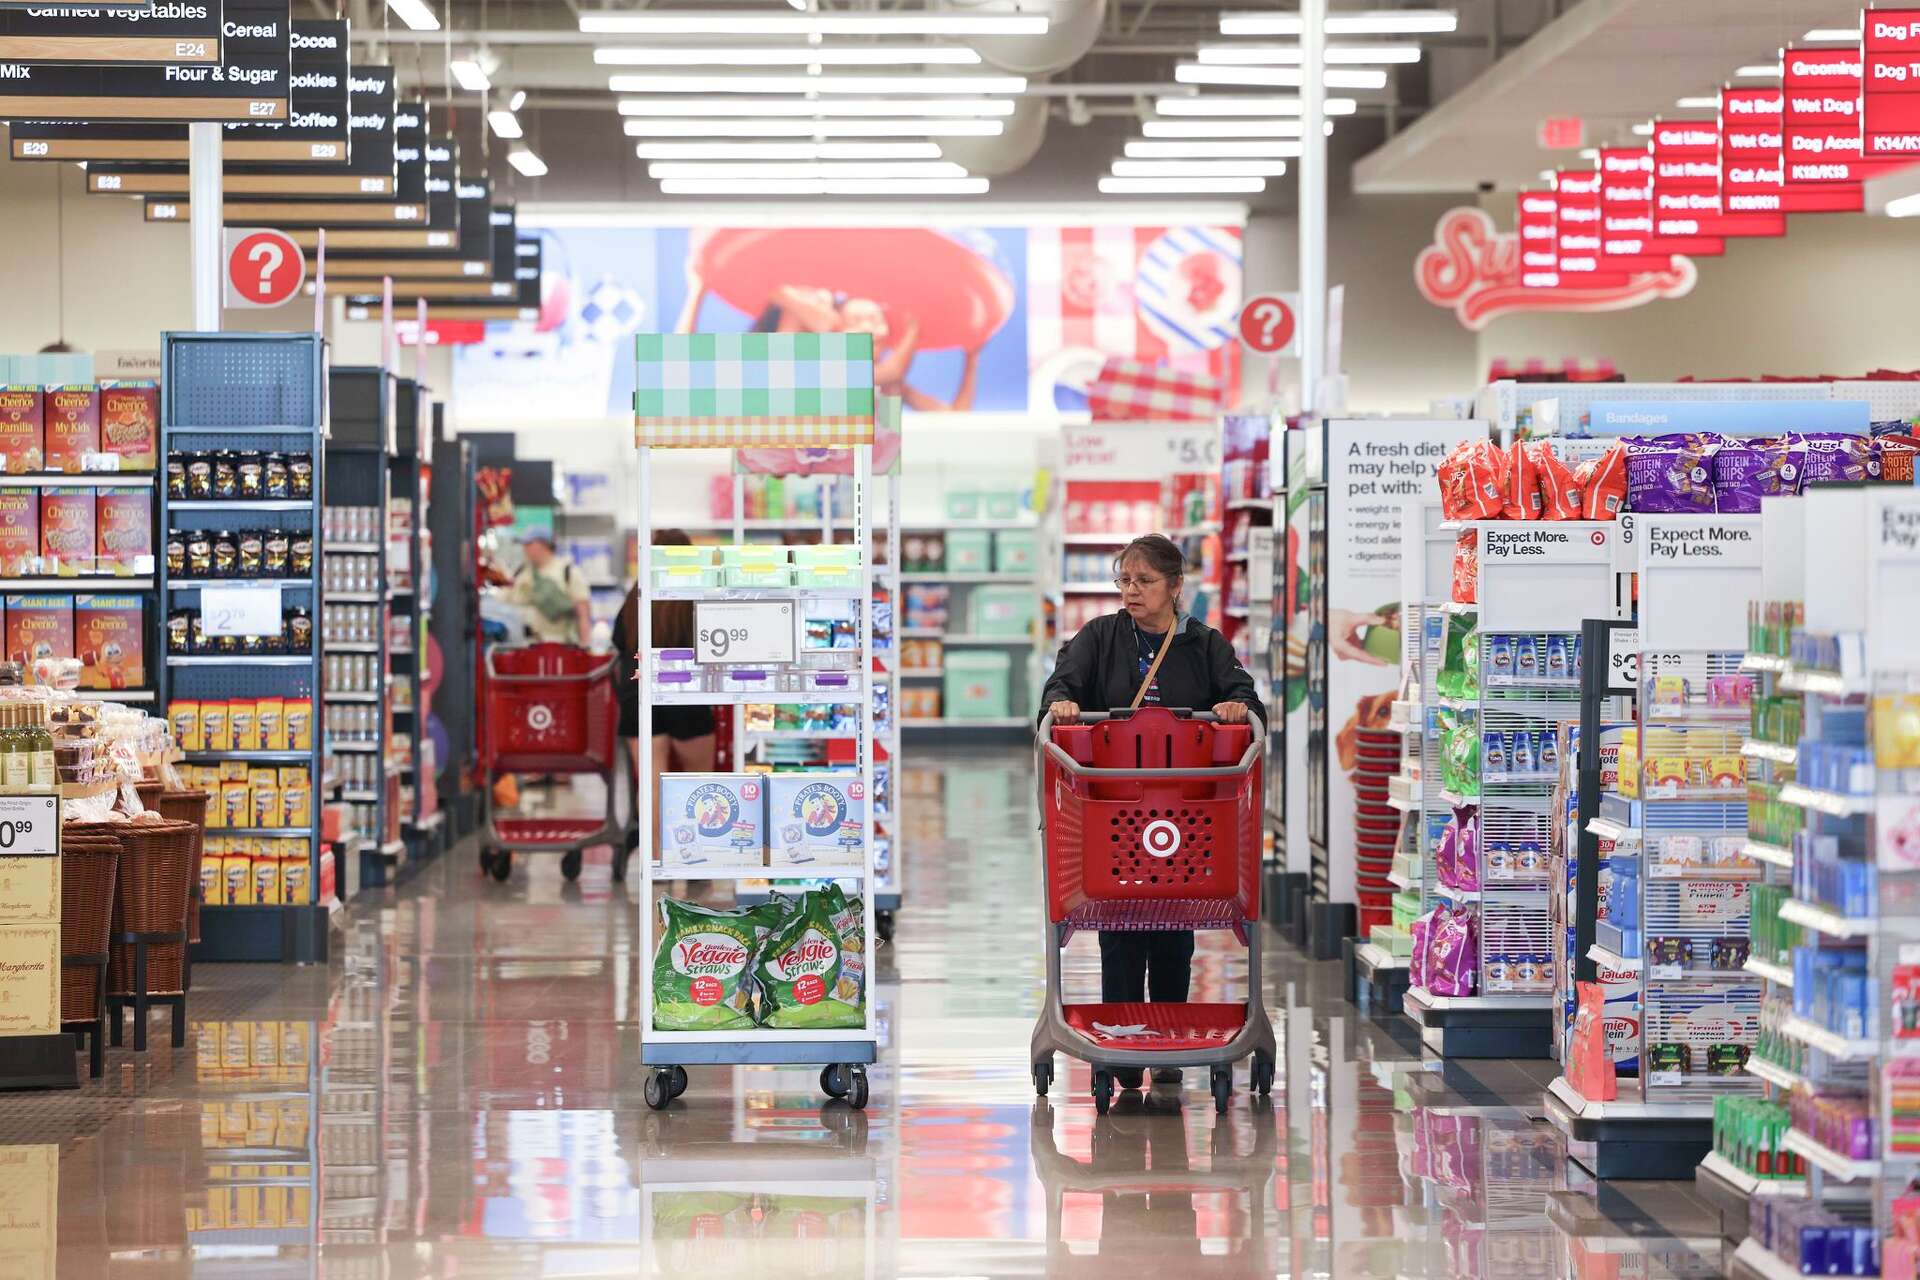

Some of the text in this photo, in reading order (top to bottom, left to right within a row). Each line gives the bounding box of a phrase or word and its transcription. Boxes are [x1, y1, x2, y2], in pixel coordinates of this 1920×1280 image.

[223, 22, 277, 38] Cereal
[1874, 23, 1907, 40] Dog
[290, 33, 337, 48] Cocoa
[175, 42, 205, 57] E24
[0, 64, 31, 79] Mix
[166, 66, 279, 84] Flour & Sugar
[1792, 61, 1862, 79] Grooming
[1874, 63, 1907, 80] Dog
[249, 102, 276, 116] E27
[1792, 98, 1853, 116] Wet Dog
[290, 112, 338, 127] Coffee
[350, 113, 386, 130] andy
[23, 142, 49, 156] E29
[1792, 136, 1823, 153] Dog
[54, 396, 91, 409] Cheerios
[107, 399, 149, 413] Cheerios
[1605, 412, 1668, 425] Bandages
[55, 421, 91, 436] My Kids
[1348, 441, 1446, 457] A fresh diet
[1348, 463, 1385, 477] may
[1389, 460, 1426, 477] help
[1348, 481, 1423, 498] pet with:
[1355, 505, 1389, 515] weight
[1355, 521, 1389, 530] energy
[1621, 515, 1634, 544] G 9
[1355, 535, 1378, 544] food
[1487, 531, 1569, 546] Expect More.
[1650, 527, 1752, 545] Expect More.
[1355, 551, 1402, 561] digestion
[1487, 544, 1546, 557] Pay Less.
[1650, 543, 1723, 558] Pay Less.
[21, 618, 58, 631] Cheerios
[91, 618, 128, 631] Cheerios
[743, 784, 756, 795] 10
[851, 784, 863, 794] 10
[679, 942, 746, 968] Veggie
[686, 962, 732, 975] straws
[784, 960, 825, 981] straws
[694, 981, 706, 990] 12
[797, 981, 807, 990] 12
